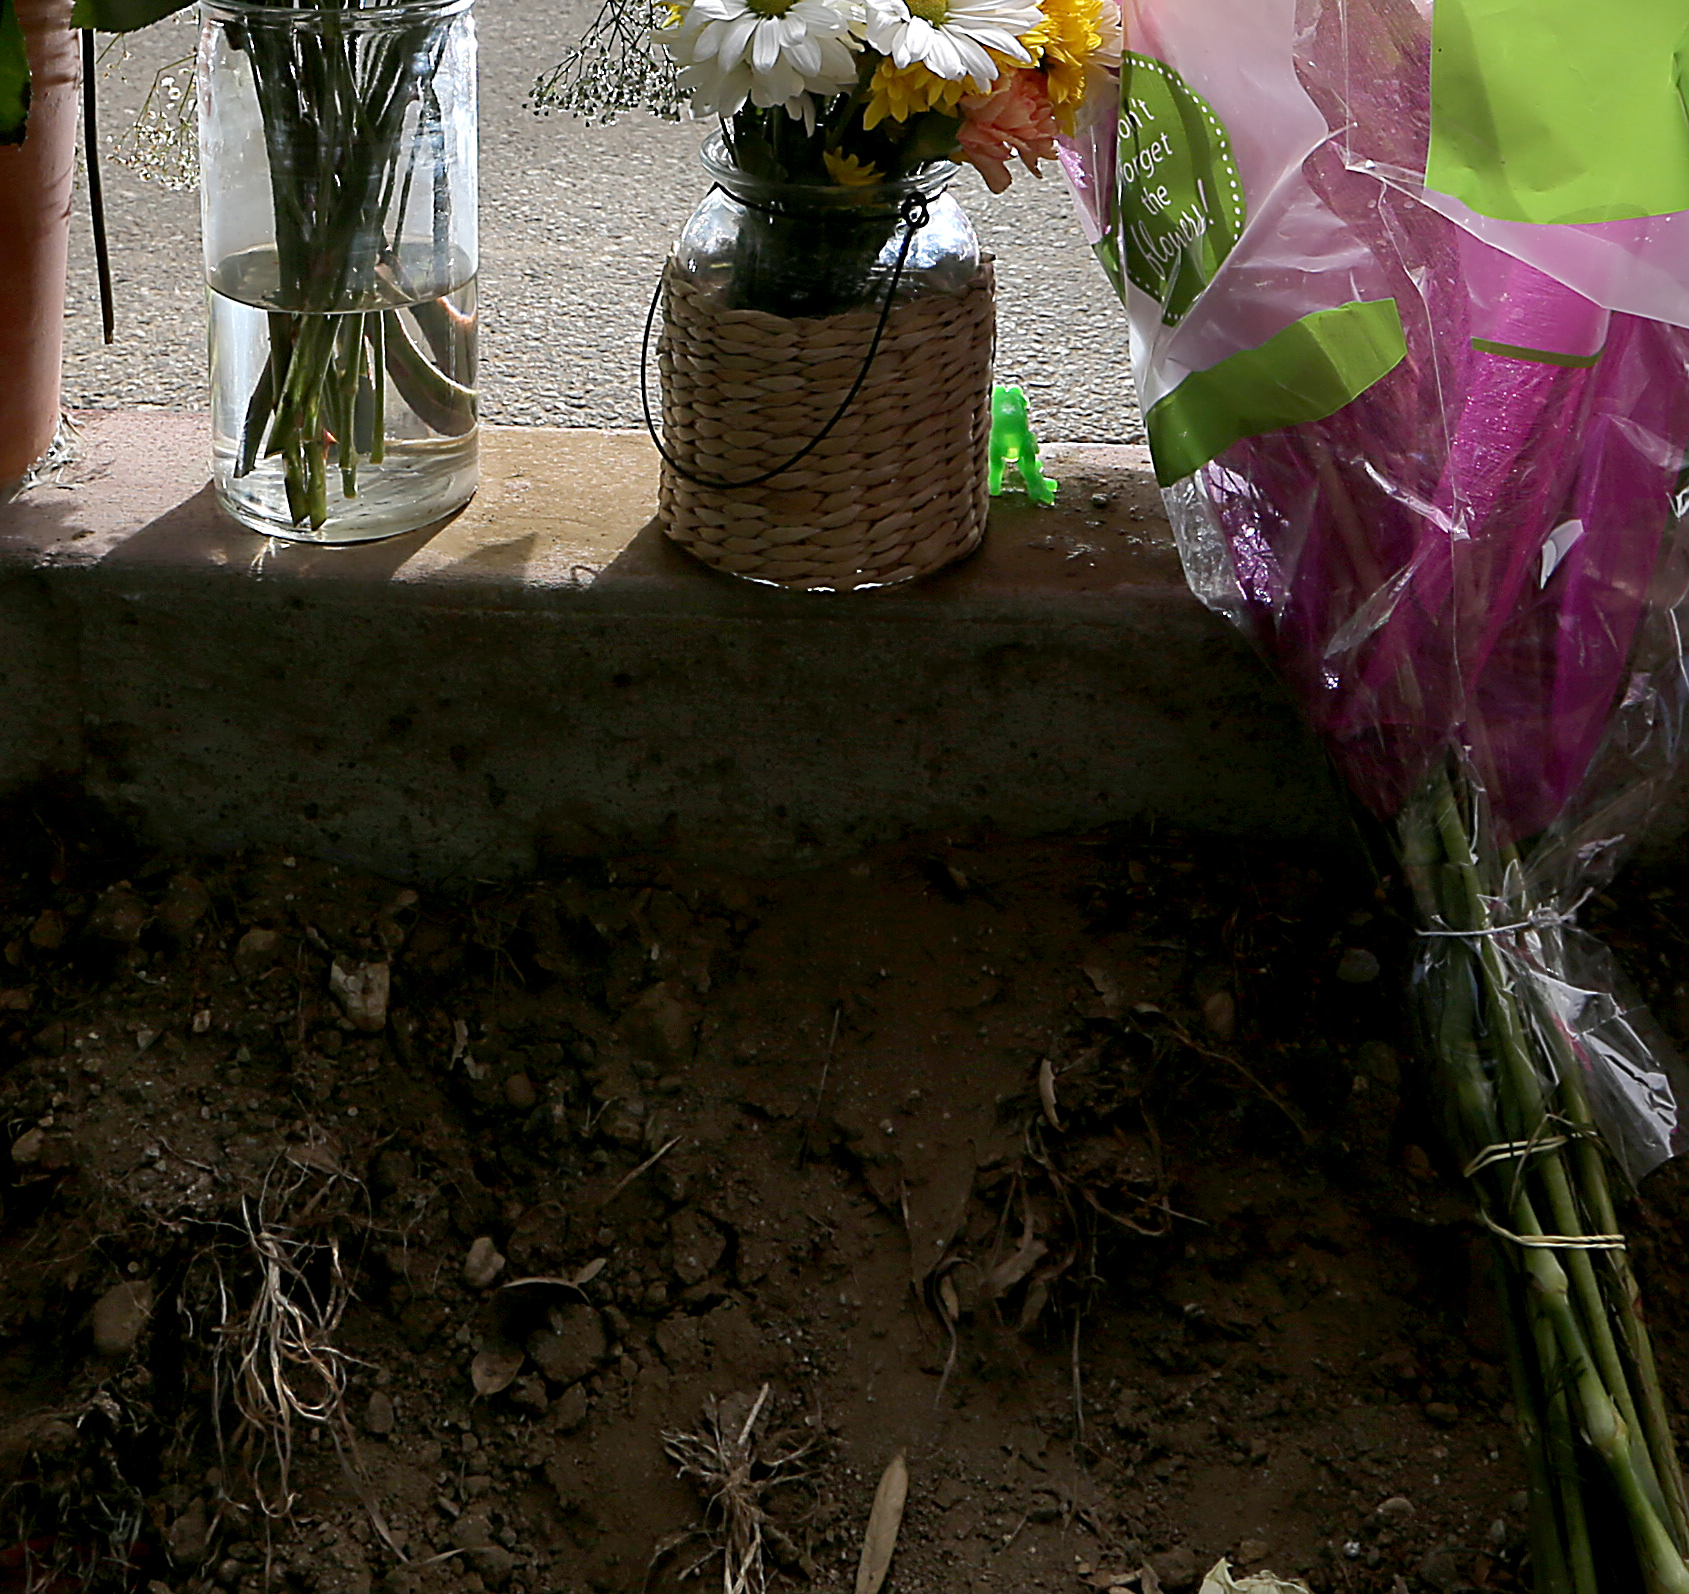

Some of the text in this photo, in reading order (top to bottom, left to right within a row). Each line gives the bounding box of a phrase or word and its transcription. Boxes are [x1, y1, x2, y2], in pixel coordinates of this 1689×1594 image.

[1117, 98, 1155, 139] on't
[1140, 185, 1172, 216] the
[1130, 178, 1214, 280] flowers!
